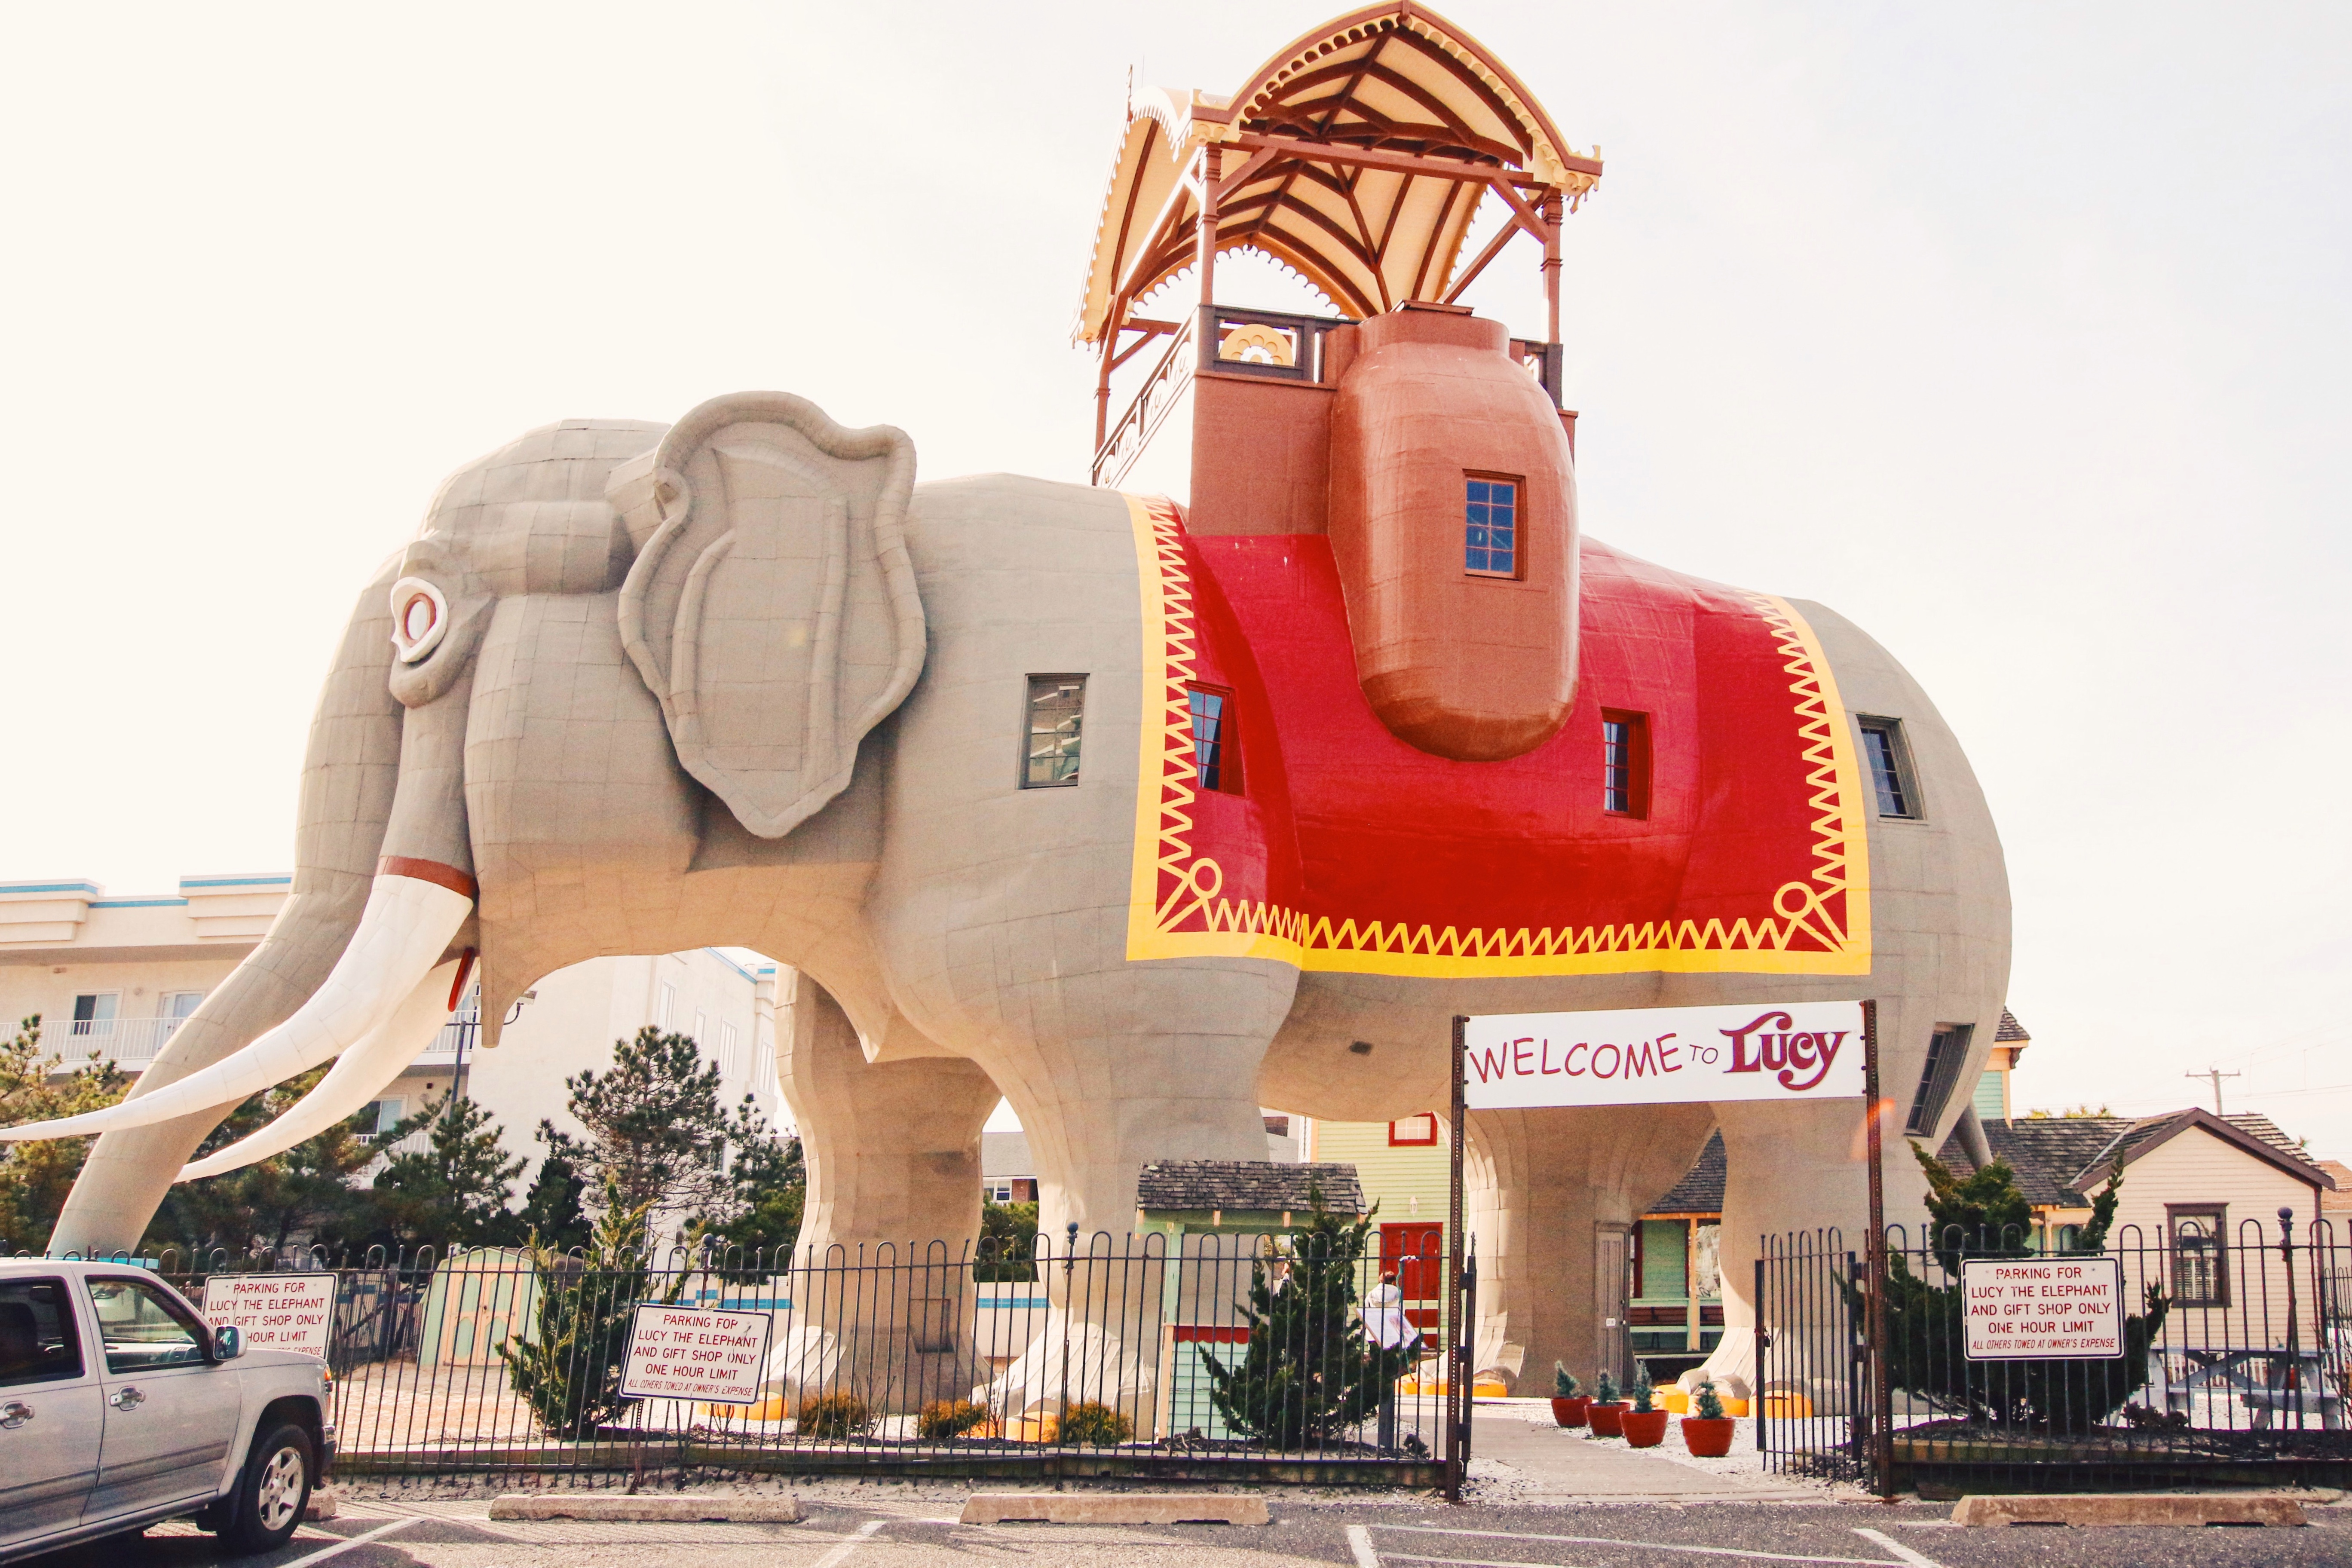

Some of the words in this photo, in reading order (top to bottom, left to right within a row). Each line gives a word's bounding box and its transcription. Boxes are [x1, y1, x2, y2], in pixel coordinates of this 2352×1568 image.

[1469, 1032, 1683, 1084] WELCOME
[1688, 1044, 1718, 1065] TO
[1718, 1011, 1850, 1091] Lucy
[1996, 1268, 2050, 1280] PARKING
[2058, 1267, 2082, 1278] FOR
[233, 1283, 279, 1294] PARKING
[285, 1282, 305, 1292] FOR
[1972, 1286, 2004, 1298] LUCY
[2011, 1286, 2035, 1297] THE
[2042, 1285, 2108, 1296] ELEPHANT
[210, 1301, 237, 1311] LUCY
[244, 1300, 263, 1310] THE
[268, 1298, 325, 1309] ELEPHANT
[1971, 1305, 1997, 1316] AND
[2004, 1304, 2030, 1315] GIFT
[2038, 1303, 2072, 1314] SHOP
[2079, 1303, 2110, 1314] ONLY
[235, 1316, 257, 1326] GIFT
[263, 1315, 291, 1326] SHOP
[297, 1314, 324, 1325] ONLY
[663, 1314, 711, 1327] PARKING
[717, 1318, 738, 1329] FOR
[1989, 1323, 2013, 1333] ONE
[2021, 1322, 2055, 1333] HOUR
[2063, 1321, 2094, 1332] LIMIT
[280, 1331, 307, 1341] LIMIT
[638, 1330, 668, 1341] LUCY
[673, 1332, 694, 1343] THE
[698, 1334, 758, 1348] ELEPHANT
[1972, 1340, 1984, 1349] ALL
[1987, 1340, 2012, 1349] OTHERS
[2014, 1340, 2035, 1349] TOWED
[2037, 1340, 2046, 1348] AT
[2048, 1338, 2077, 1348] OWNER'S
[2081, 1338, 2115, 1348] EXPENSE
[634, 1347, 657, 1357] AND
[663, 1348, 686, 1360] GIFT
[692, 1351, 722, 1362] SHOP
[728, 1353, 756, 1365] ONLY
[646, 1364, 667, 1375] ONE
[673, 1366, 704, 1378] HOUR
[710, 1369, 738, 1380] LIMIT
[628, 1379, 638, 1387] ALL
[640, 1380, 663, 1389] OTHERS
[664, 1381, 683, 1391] TOWED
[692, 1384, 719, 1393] OWNER'S
[722, 1386, 753, 1396] EXPENSE
